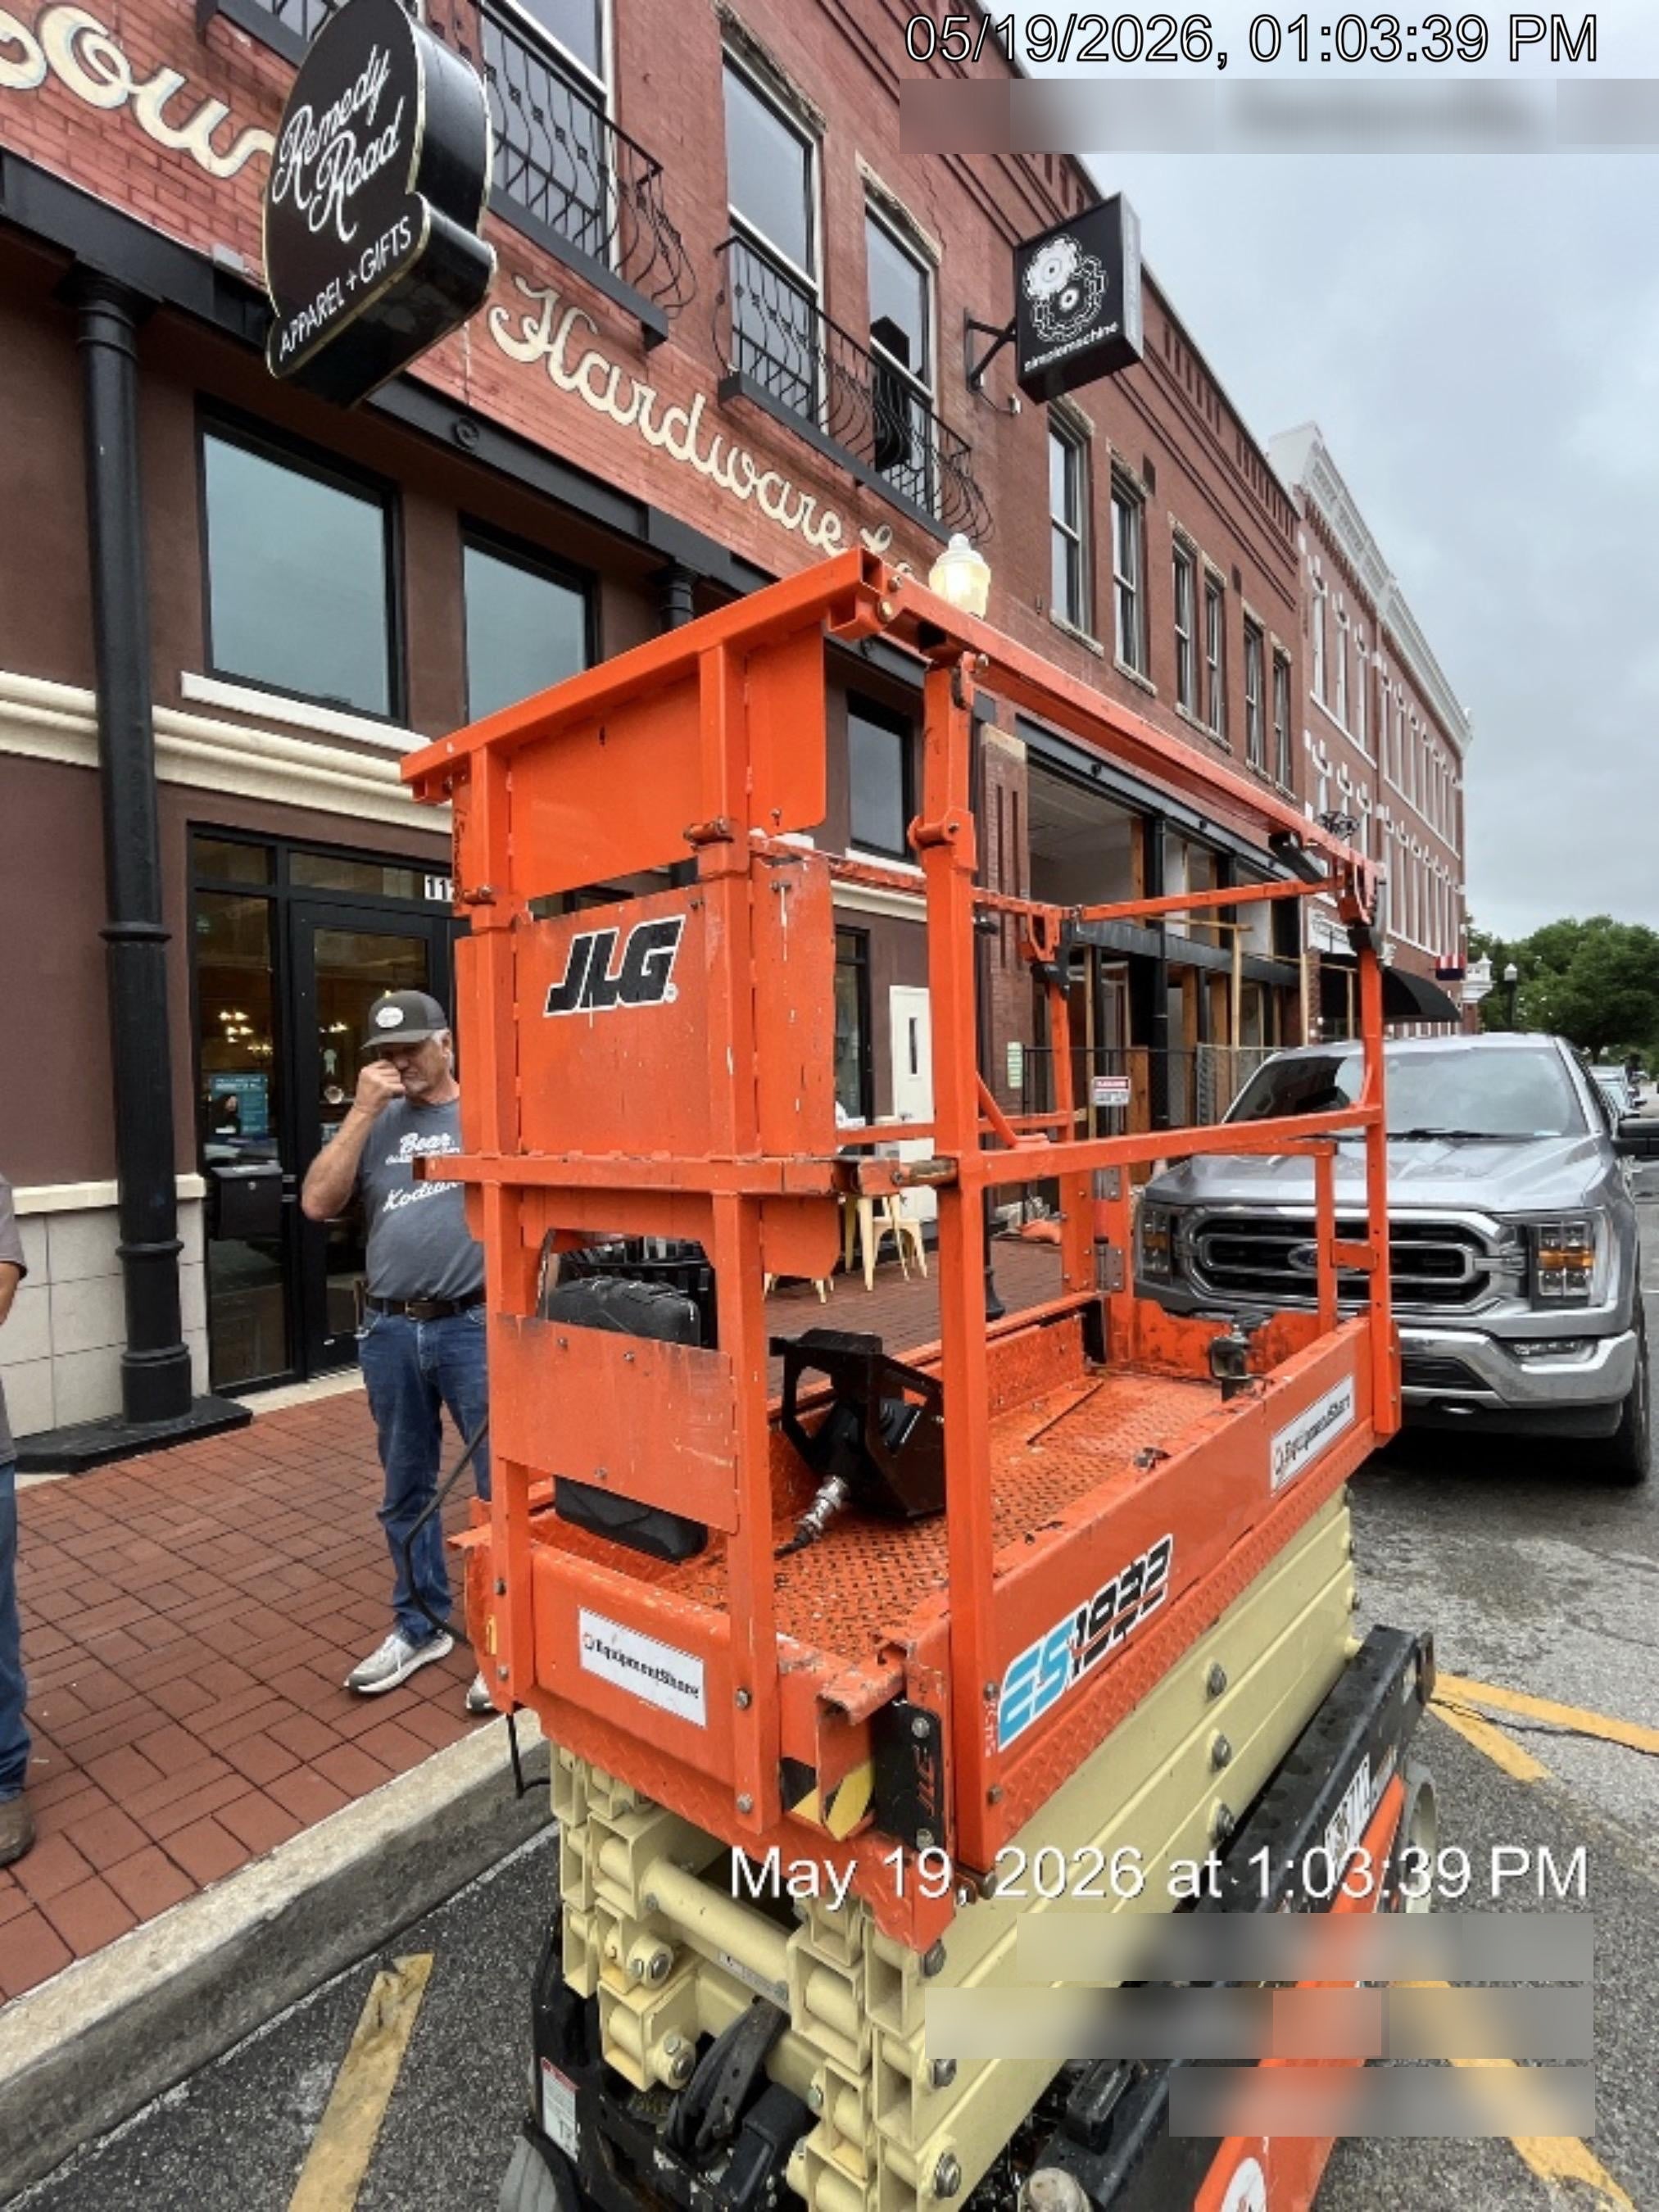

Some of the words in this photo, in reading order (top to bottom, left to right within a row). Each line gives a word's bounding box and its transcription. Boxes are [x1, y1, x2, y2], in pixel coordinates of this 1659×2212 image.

[272, 44, 391, 210] Remedy
[309, 95, 405, 243] Road
[279, 277, 345, 362] APPAREL
[346, 270, 357, 291] +
[360, 215, 411, 283] GIFTS
[489, 276, 849, 557] Hardware
[542, 913, 687, 1018] JLG
[998, 1532, 1173, 1753] ES1932
